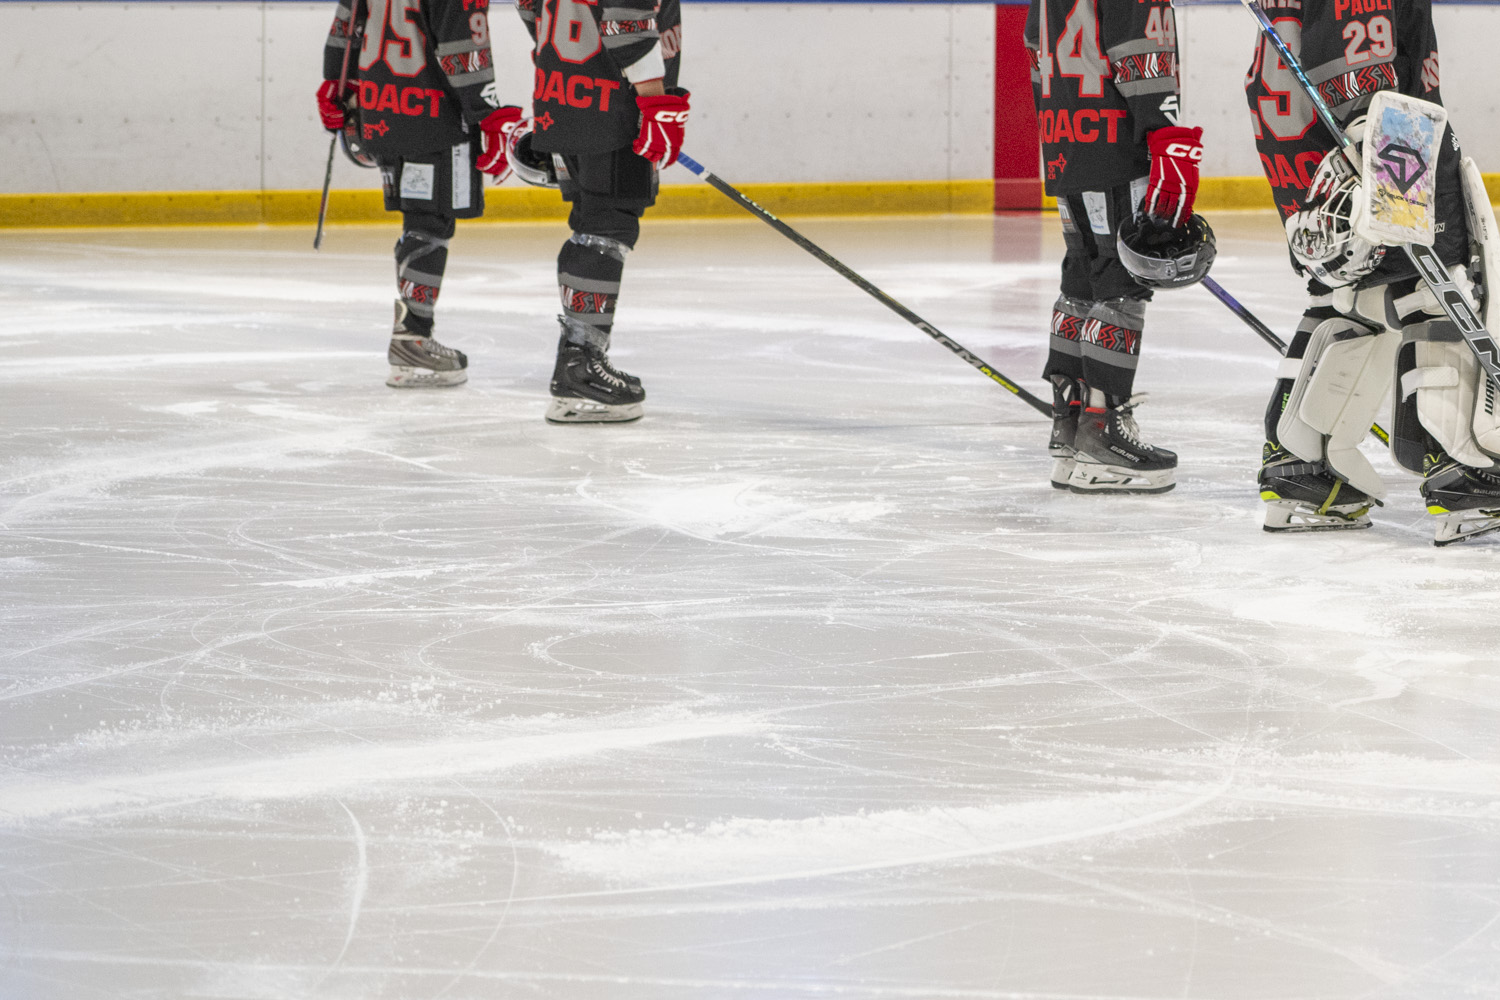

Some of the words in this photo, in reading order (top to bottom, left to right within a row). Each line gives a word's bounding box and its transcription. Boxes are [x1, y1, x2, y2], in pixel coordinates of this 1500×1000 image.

[1144, 6, 1175, 47] 44
[1342, 15, 1394, 66] 29
[914, 321, 982, 369] CCM
[1110, 445, 1140, 463] BAUER
